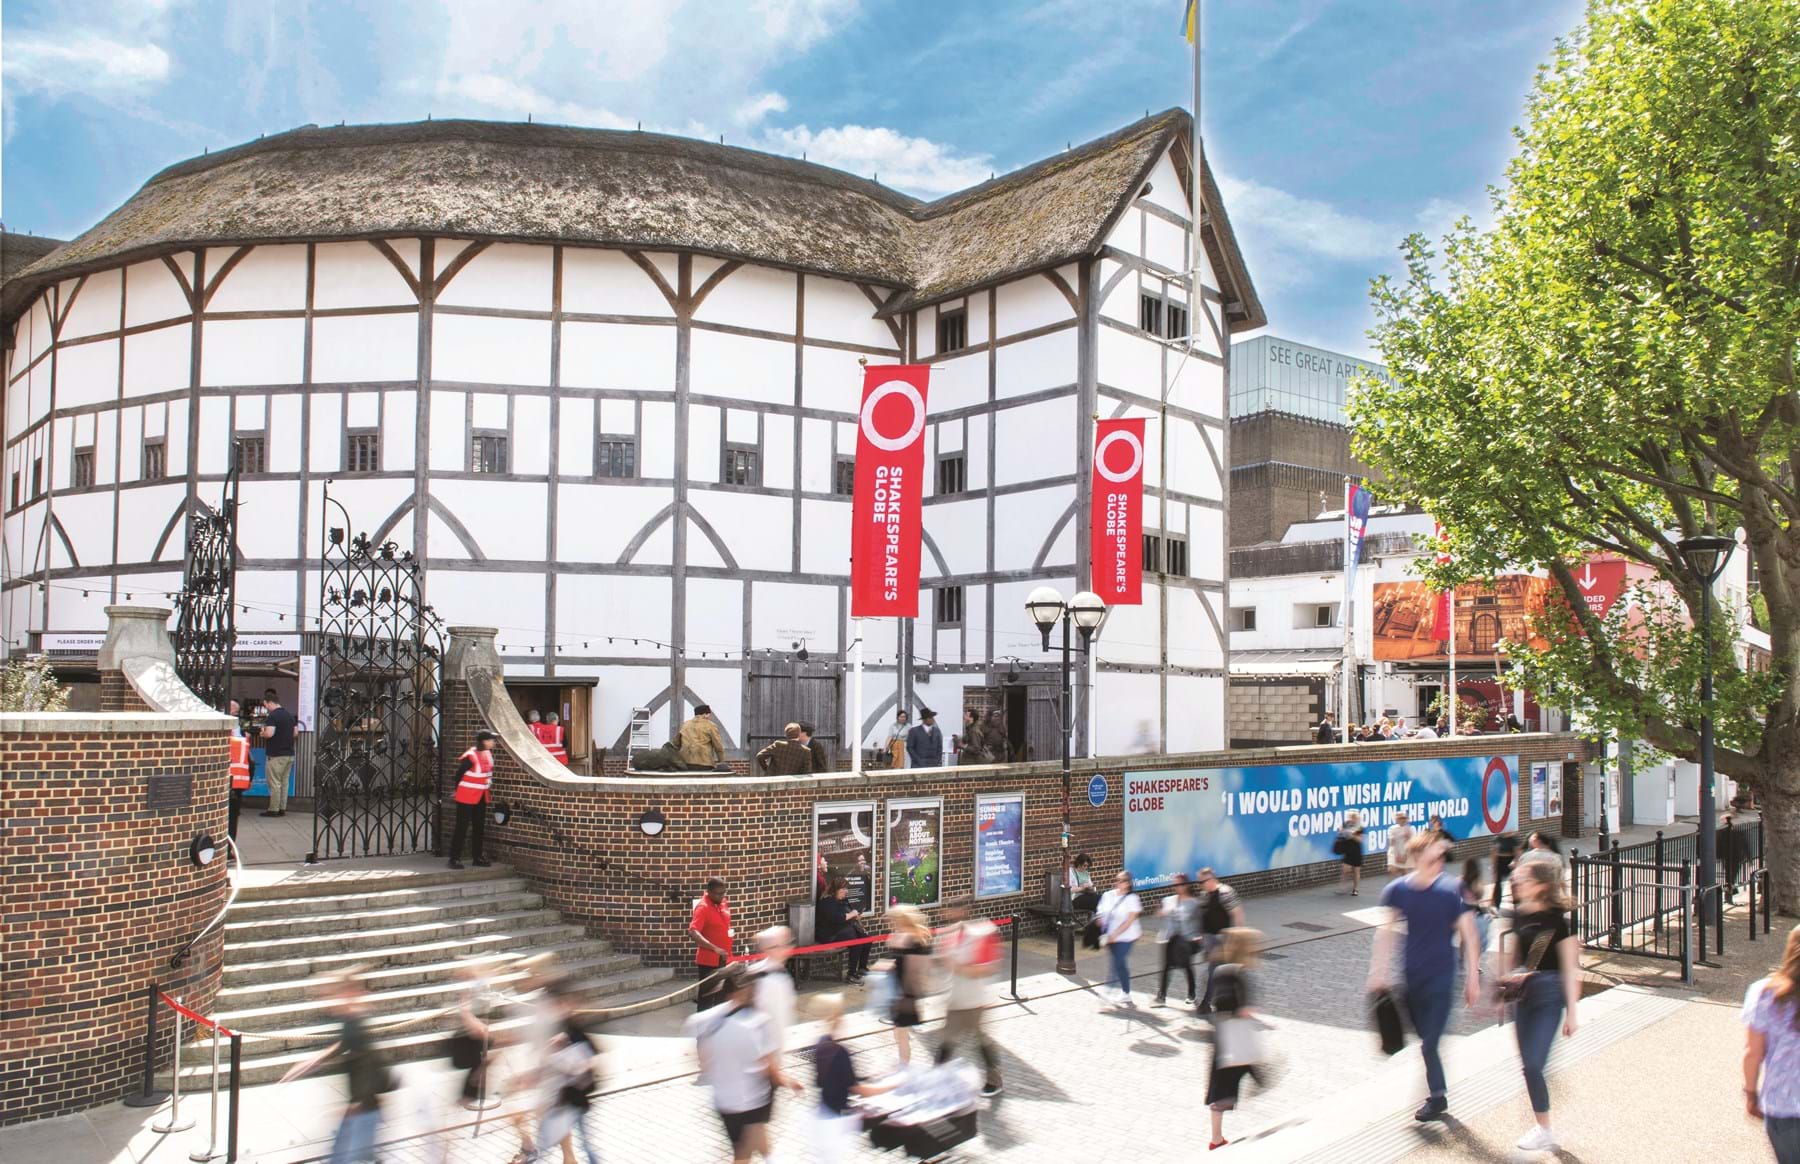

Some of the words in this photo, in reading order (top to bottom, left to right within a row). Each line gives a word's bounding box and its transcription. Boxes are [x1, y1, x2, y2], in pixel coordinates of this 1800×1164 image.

[1270, 346, 1291, 365] SEE
[1296, 352, 1332, 376] GREAT
[1336, 361, 1357, 379] ART
[873, 465, 888, 524] GLOBE
[1106, 493, 1117, 536] GLOBE
[884, 465, 903, 601] SHAKESPEARE'S
[1116, 493, 1127, 593] SHAKESPEARE'S
[1584, 595, 1606, 604] IDED
[1129, 777, 1209, 795] SHAKESPEARE'S
[1239, 788, 1301, 815] WOULD
[1306, 786, 1340, 809] NOT
[1343, 782, 1381, 805] WISH
[1383, 780, 1412, 802] ANY
[979, 805, 1006, 813] SUMMER
[1129, 797, 1164, 812] GLOBE
[1288, 807, 1380, 838] COMPAON
[1428, 797, 1469, 820] WORLD
[1368, 828, 1391, 851] BU
